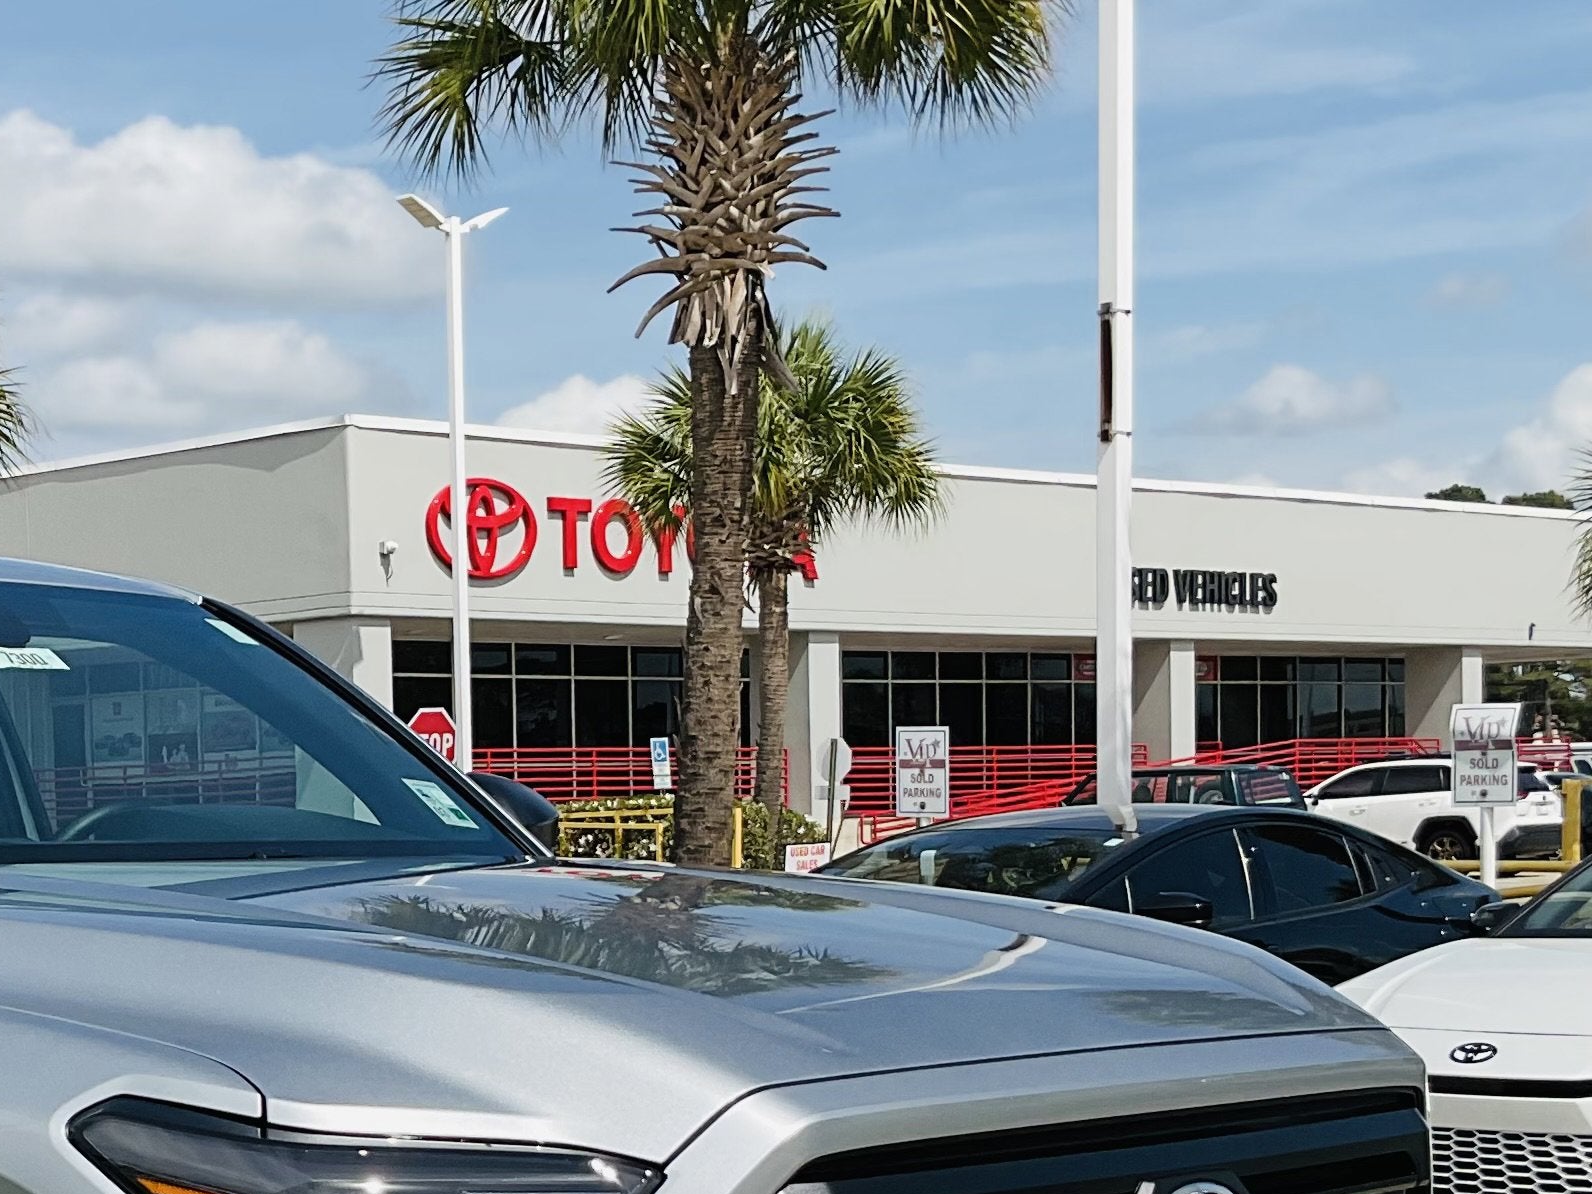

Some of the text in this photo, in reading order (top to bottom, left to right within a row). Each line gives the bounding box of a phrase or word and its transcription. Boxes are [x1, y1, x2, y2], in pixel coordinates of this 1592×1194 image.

[1132, 567, 1278, 607] SED VEHICLES
[0, 651, 49, 666] 7300
[1469, 758, 1499, 769] SOLD
[910, 773, 934, 784] SOLD
[1459, 774, 1508, 786] PARKING
[903, 787, 942, 798] PARKING
[790, 845, 826, 857] USED CAR
